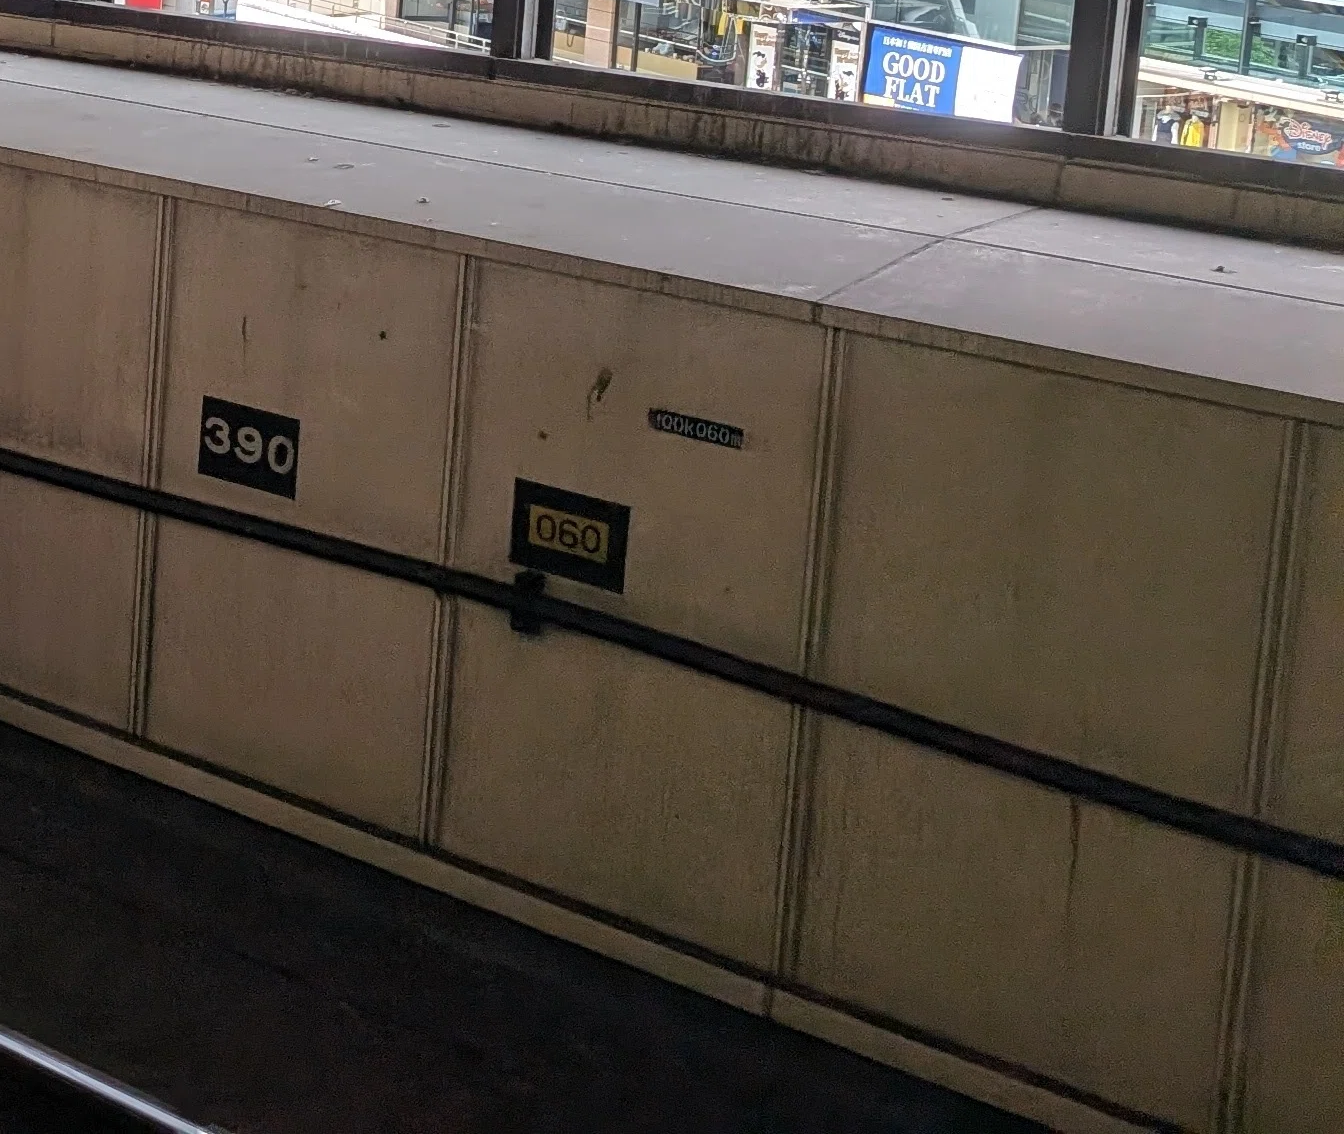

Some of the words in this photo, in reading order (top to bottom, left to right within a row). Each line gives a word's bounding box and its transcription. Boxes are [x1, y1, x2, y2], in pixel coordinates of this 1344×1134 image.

[883, 51, 946, 83] GOOD
[883, 75, 940, 108] FLAT
[204, 416, 295, 475] 390
[536, 514, 602, 554] 060
